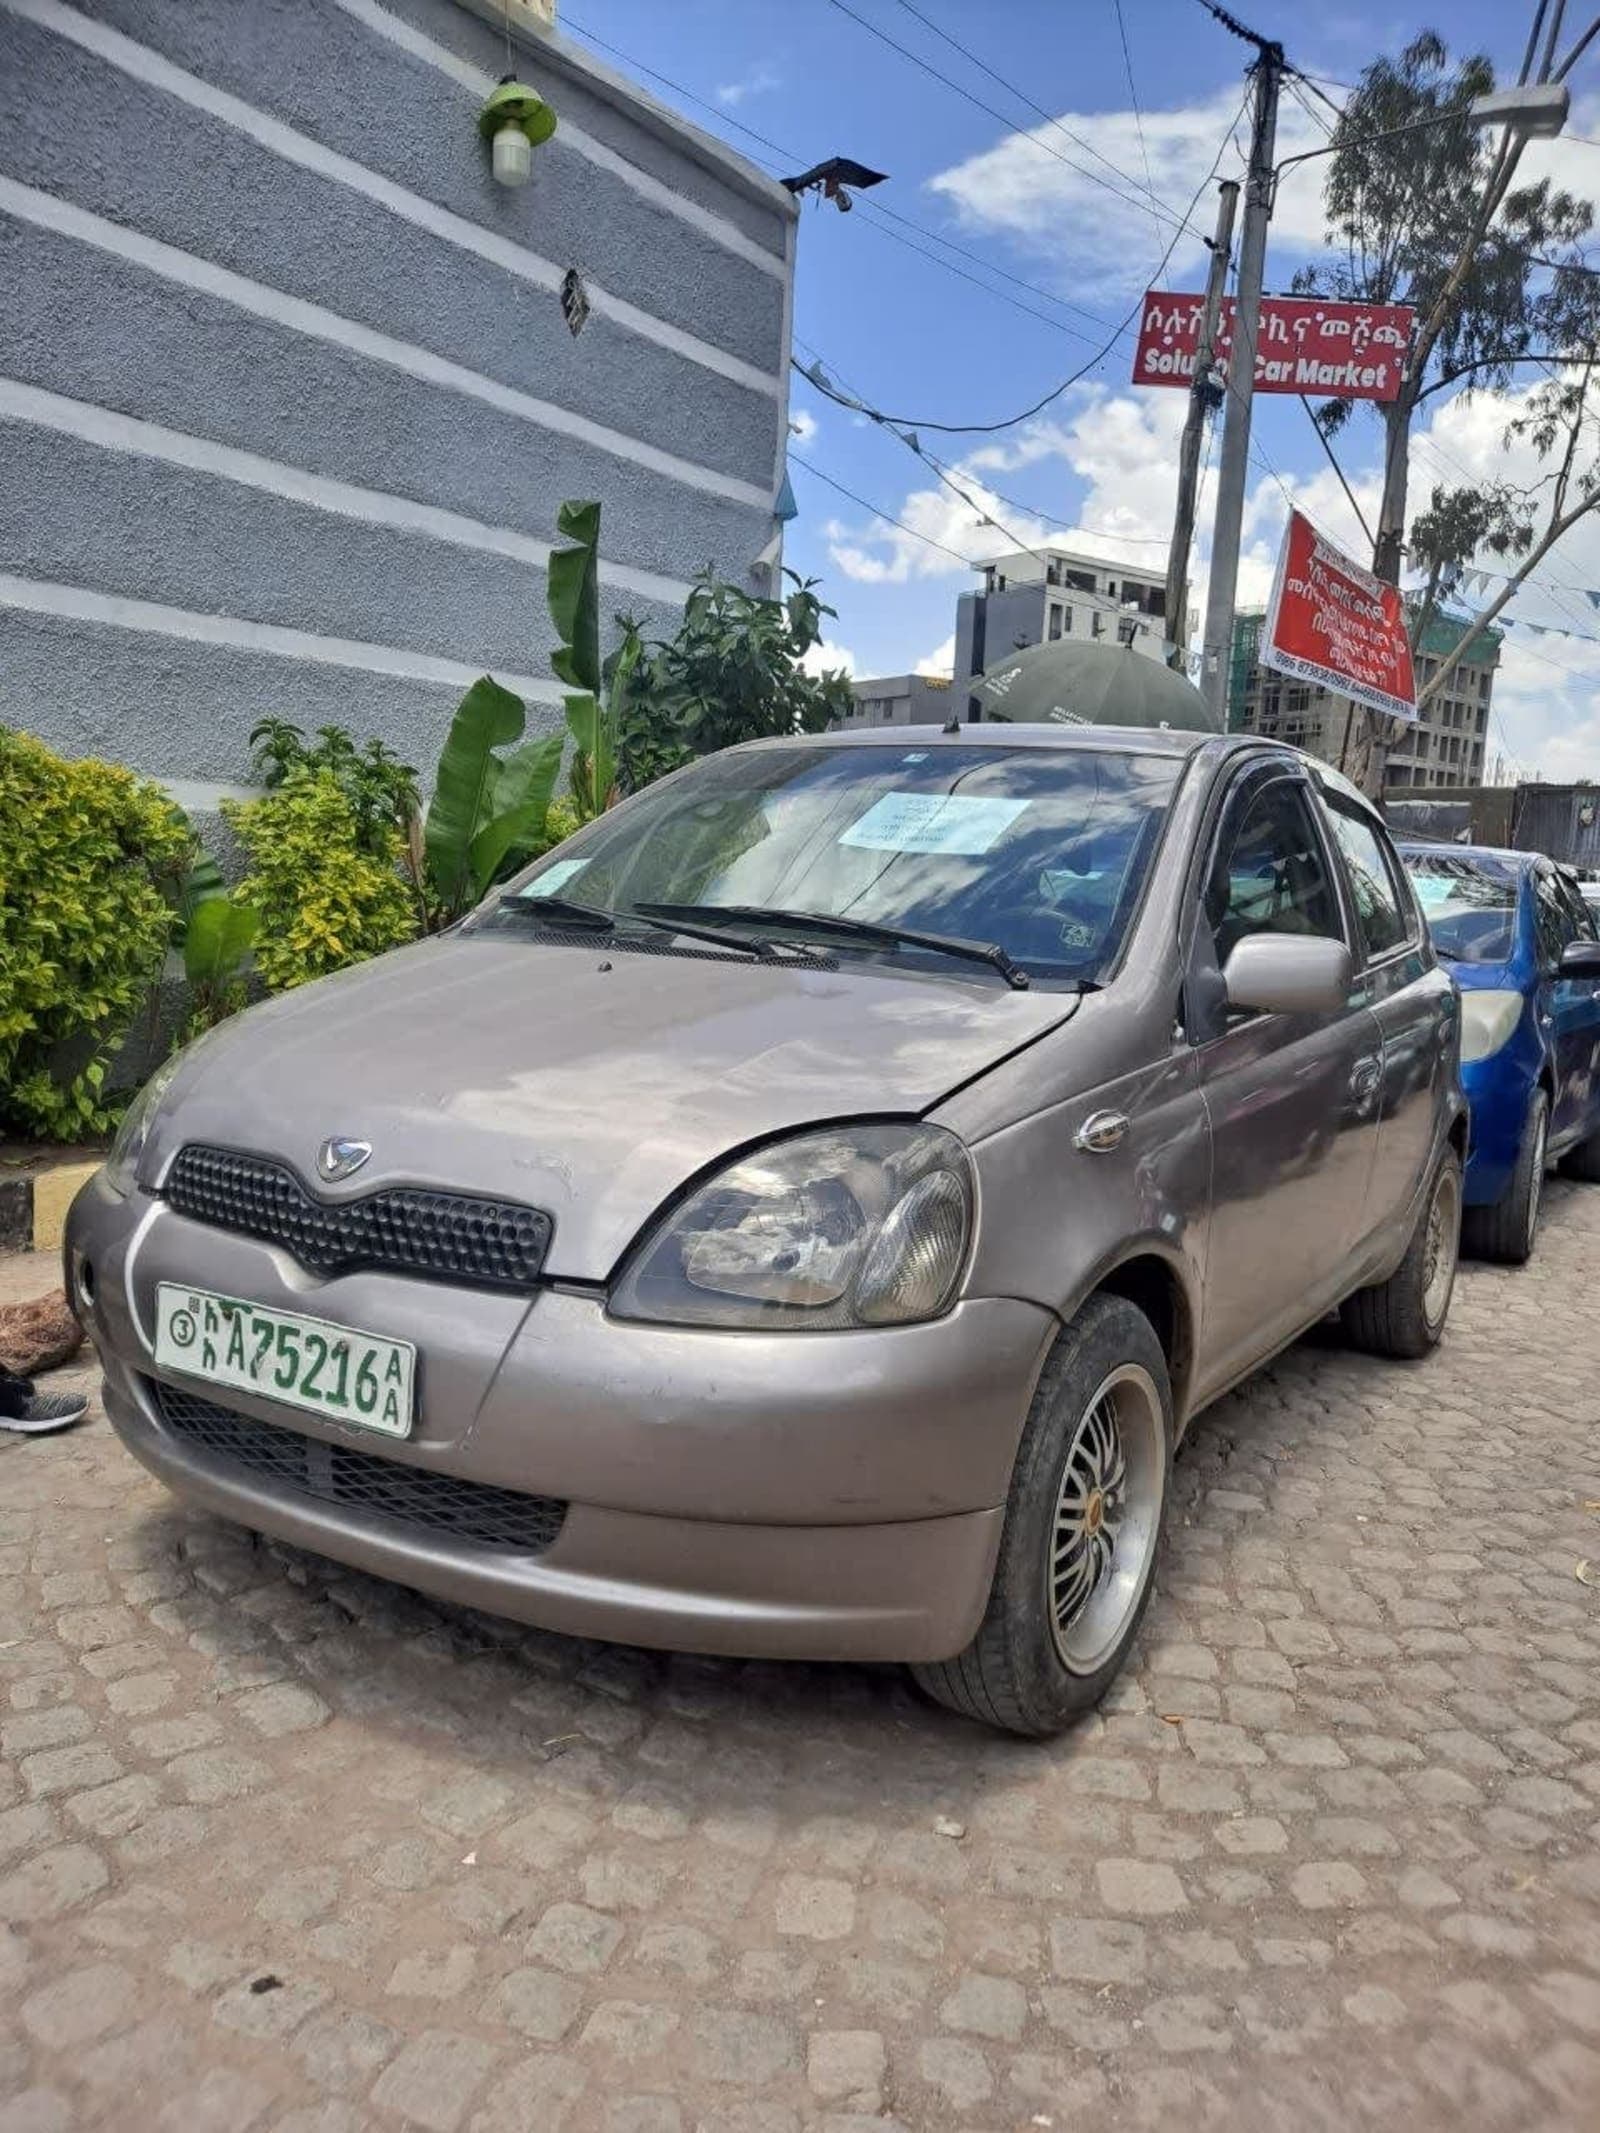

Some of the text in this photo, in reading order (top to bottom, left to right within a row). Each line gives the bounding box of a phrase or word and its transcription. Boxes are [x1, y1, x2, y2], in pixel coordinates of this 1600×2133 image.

[1257, 313, 1311, 344] ኪና
[1295, 357, 1388, 390] Market
[227, 1311, 378, 1413] A75216
